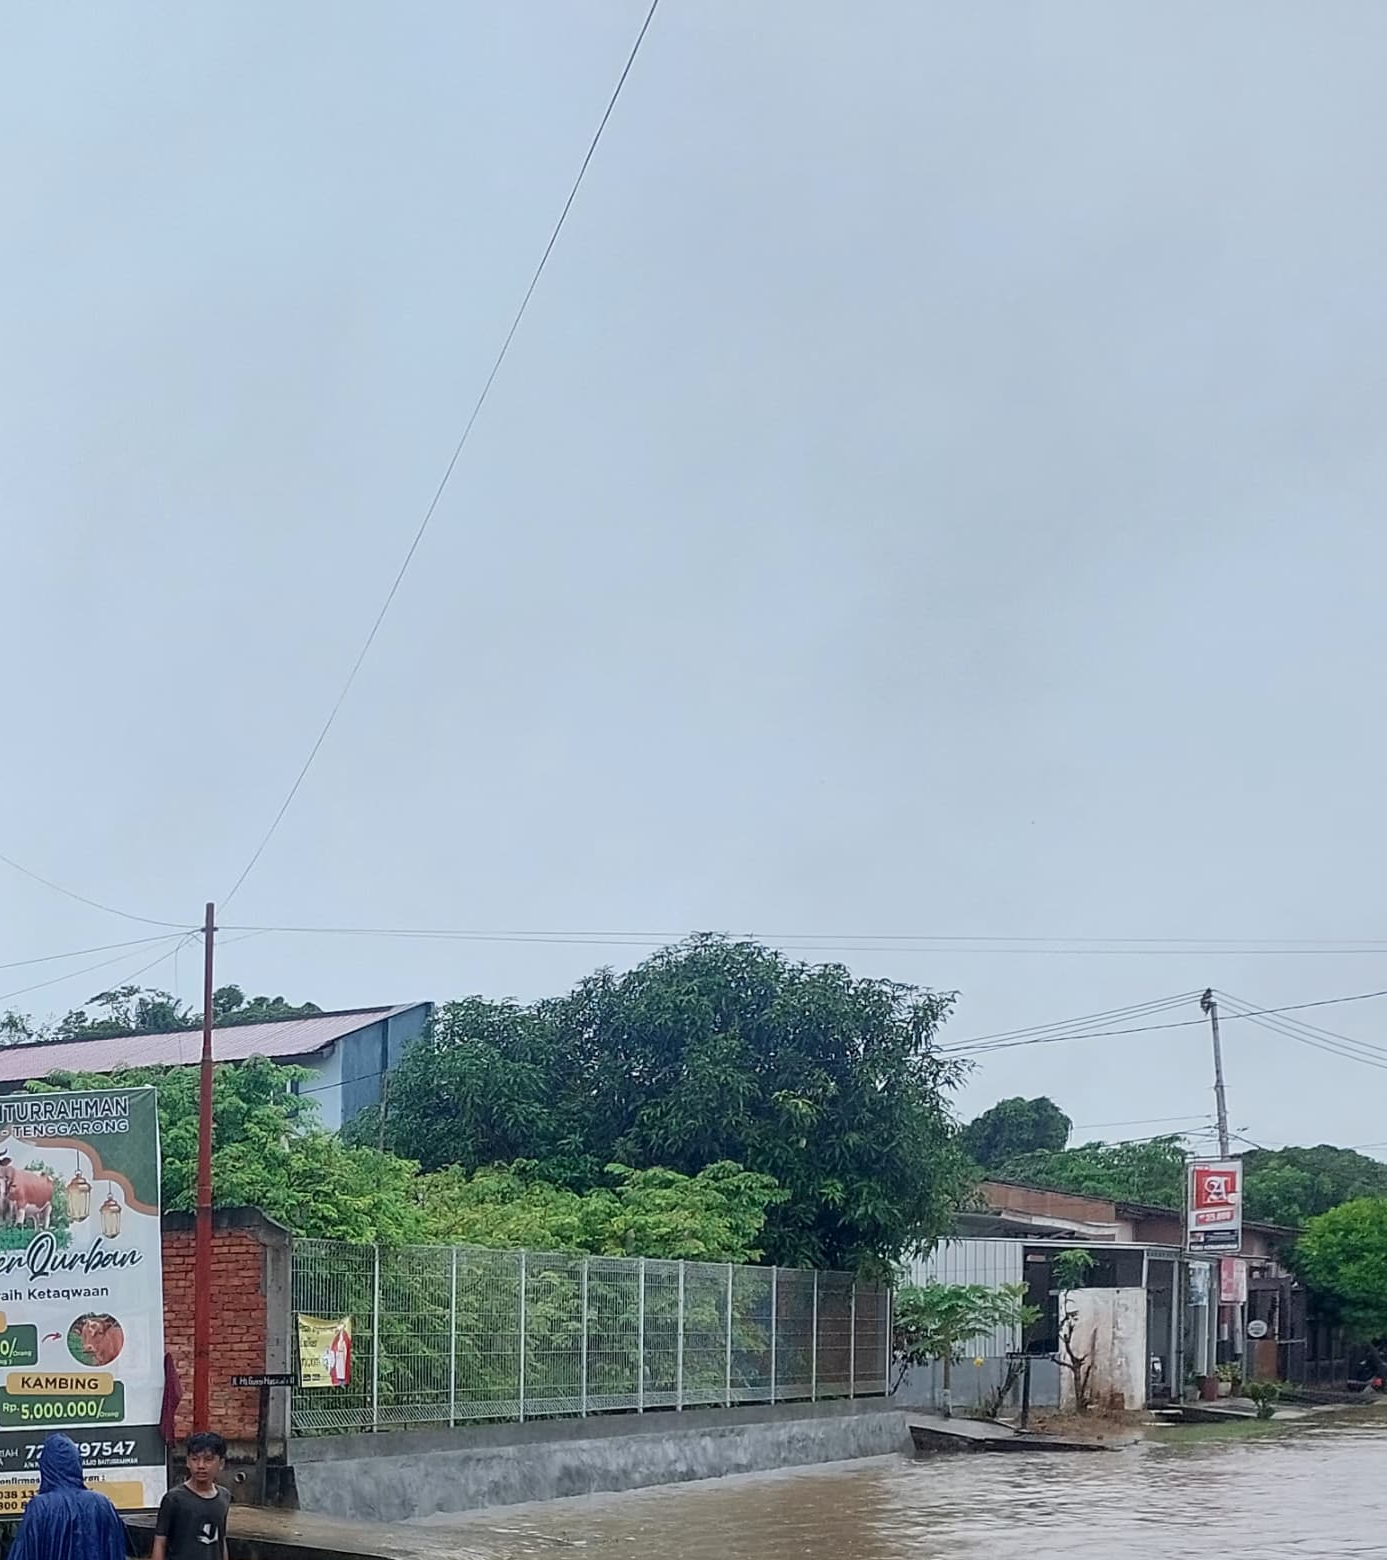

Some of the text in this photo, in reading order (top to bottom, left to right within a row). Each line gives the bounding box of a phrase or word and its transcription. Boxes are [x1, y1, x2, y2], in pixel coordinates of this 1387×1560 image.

[13, 1119, 129, 1138] TENGGARONG
[27, 1285, 110, 1300] Ketaqwaan
[20, 1376, 100, 1390] KAMBING
